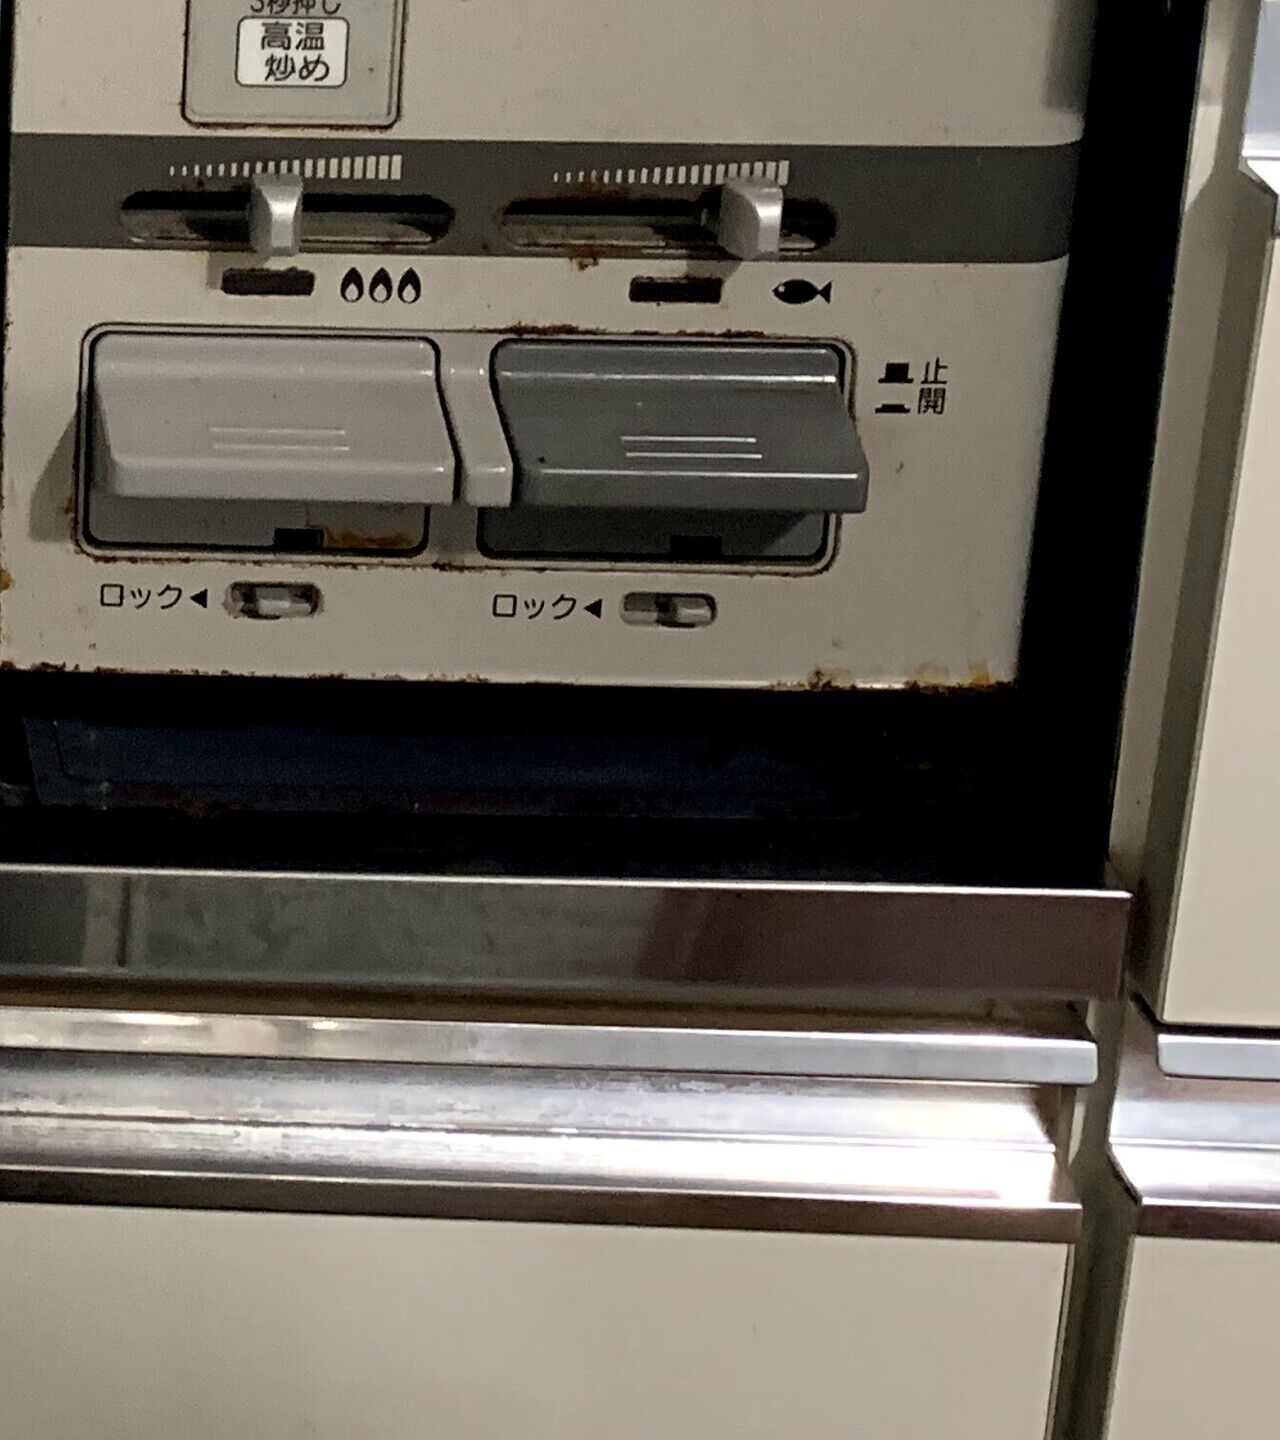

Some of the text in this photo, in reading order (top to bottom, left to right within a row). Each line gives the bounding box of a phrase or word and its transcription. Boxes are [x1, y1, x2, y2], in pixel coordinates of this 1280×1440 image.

[260, 21, 325, 51] 高温
[264, 53, 331, 82] 炒め
[920, 356, 949, 385] 止
[100, 583, 183, 610] ロック
[492, 593, 577, 620] ロック
